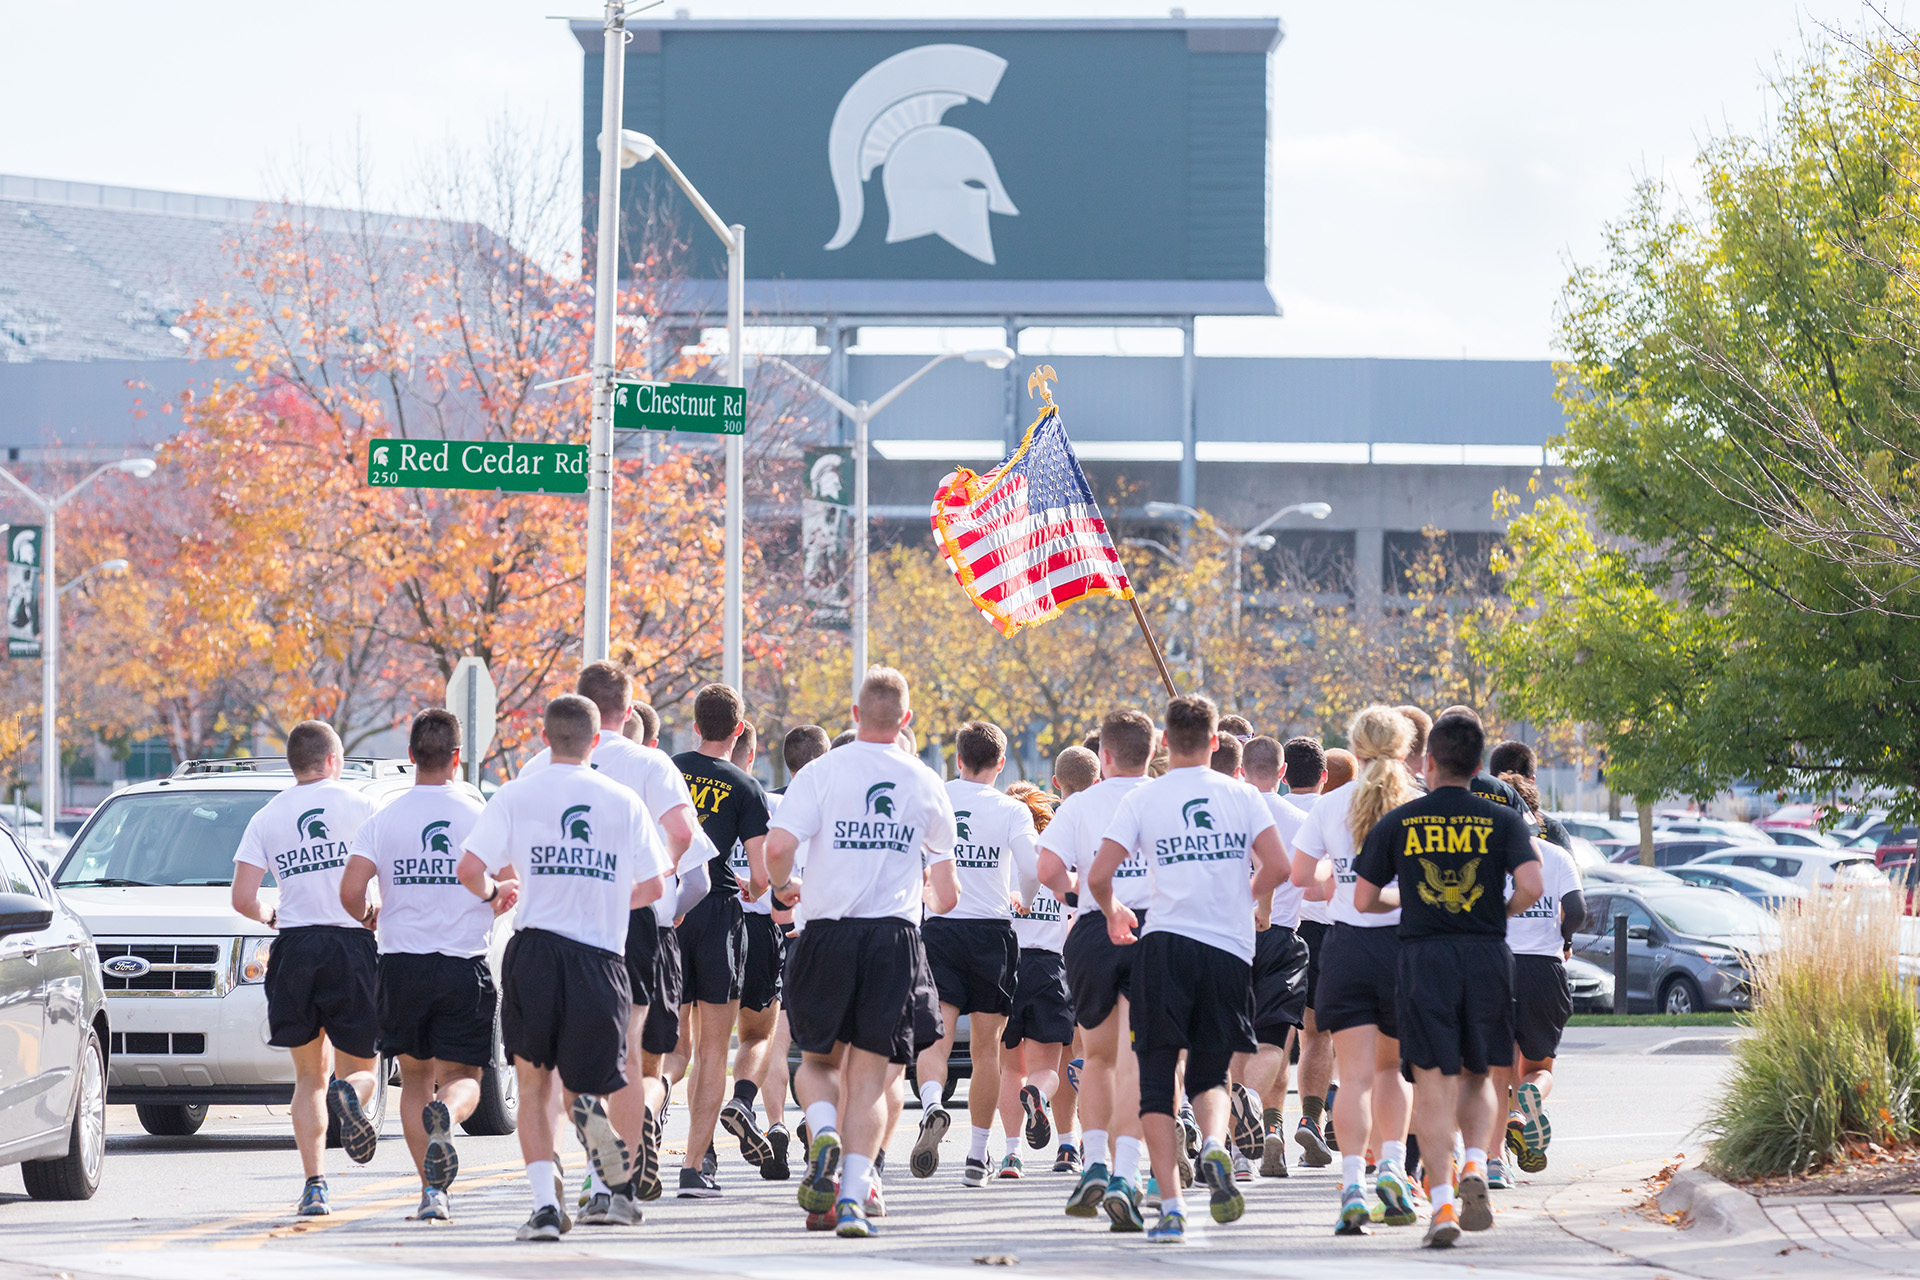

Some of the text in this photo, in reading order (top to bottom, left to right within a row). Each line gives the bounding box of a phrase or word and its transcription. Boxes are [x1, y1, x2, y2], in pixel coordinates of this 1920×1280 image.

[637, 385, 742, 417] Chestnut Rd
[724, 420, 742, 433] 300
[399, 443, 583, 475] Red Cedar Rd
[372, 472, 398, 484] 250
[695, 776, 733, 791] STATES
[690, 783, 730, 813] MY
[1402, 815, 1494, 827] UNITED STATES
[1156, 832, 1246, 856] SPARTAN
[1403, 825, 1494, 857] ARMY
[275, 841, 352, 870] SPARTA
[531, 846, 617, 871] SPARTAN
[955, 844, 1000, 860] RTAN
[279, 858, 345, 880] BATTALI
[394, 858, 457, 875] SPART
[956, 860, 998, 868] ALION
[393, 876, 462, 885] BATTALI
[114, 961, 137, 971] Ford
